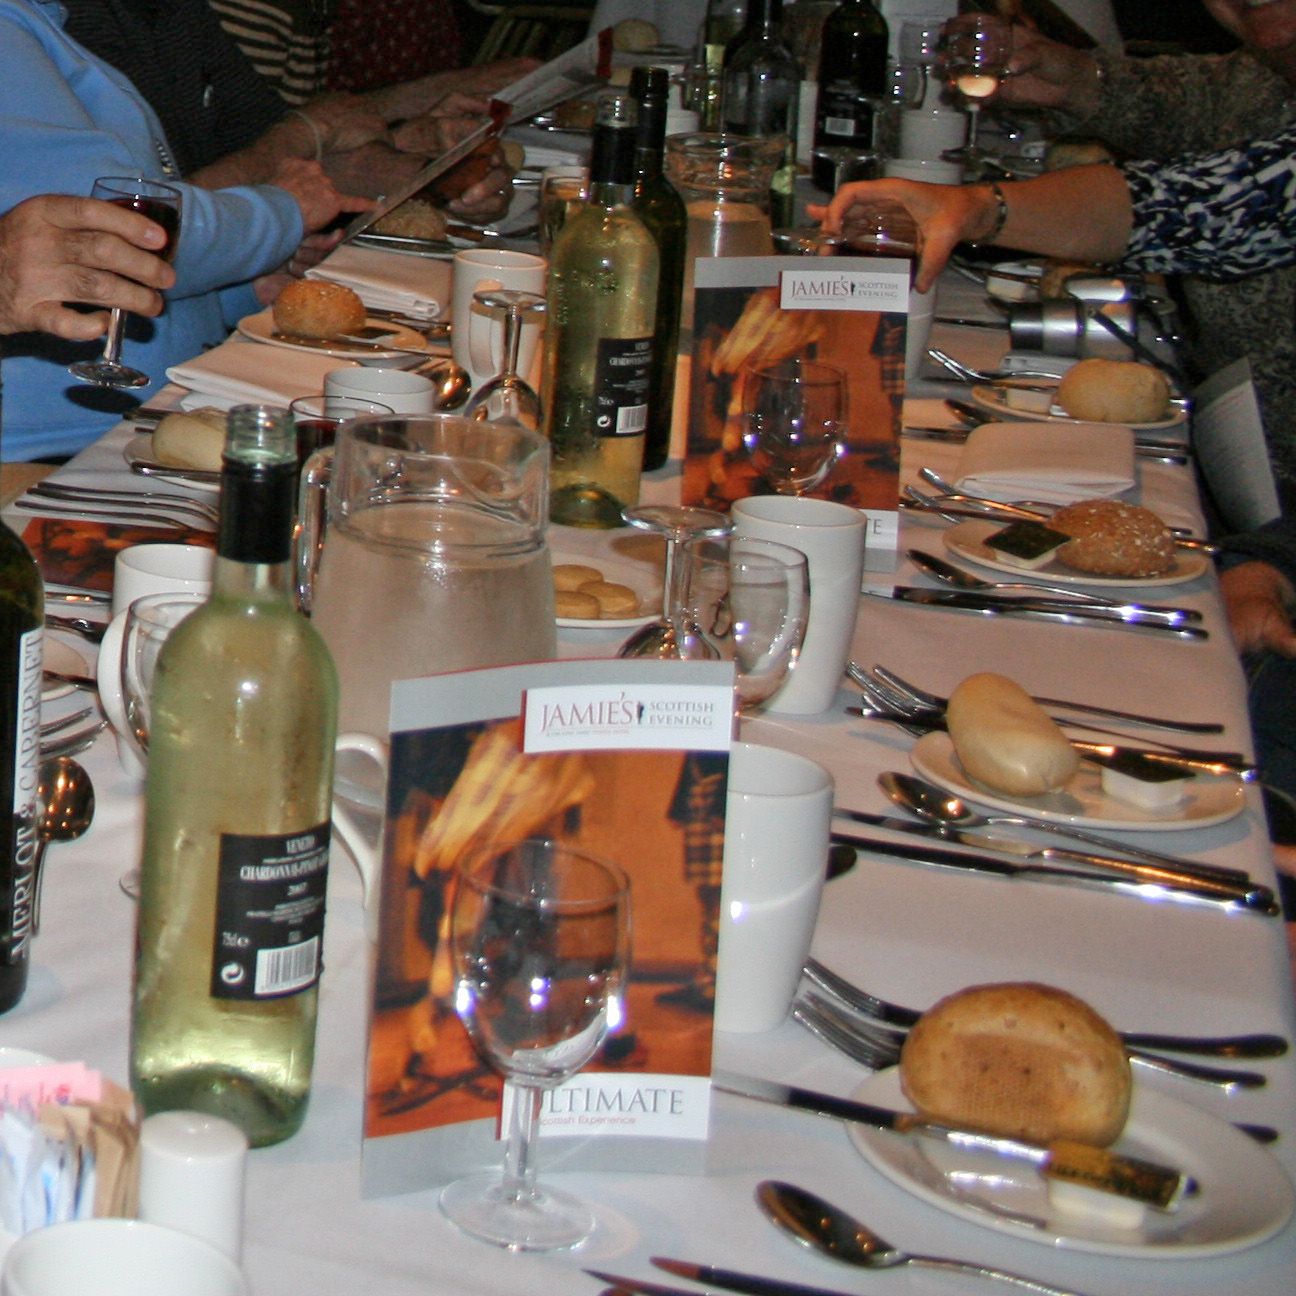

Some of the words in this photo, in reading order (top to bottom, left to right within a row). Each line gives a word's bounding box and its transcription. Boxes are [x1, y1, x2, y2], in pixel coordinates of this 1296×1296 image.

[791, 275, 849, 297] JAMIE'S
[541, 691, 634, 731] JAMIE'S
[649, 701, 714, 713] SCOTTISH
[648, 714, 713, 726] EVENING
[546, 1086, 684, 1115] LTIMATE
[540, 1115, 575, 1126] cottish
